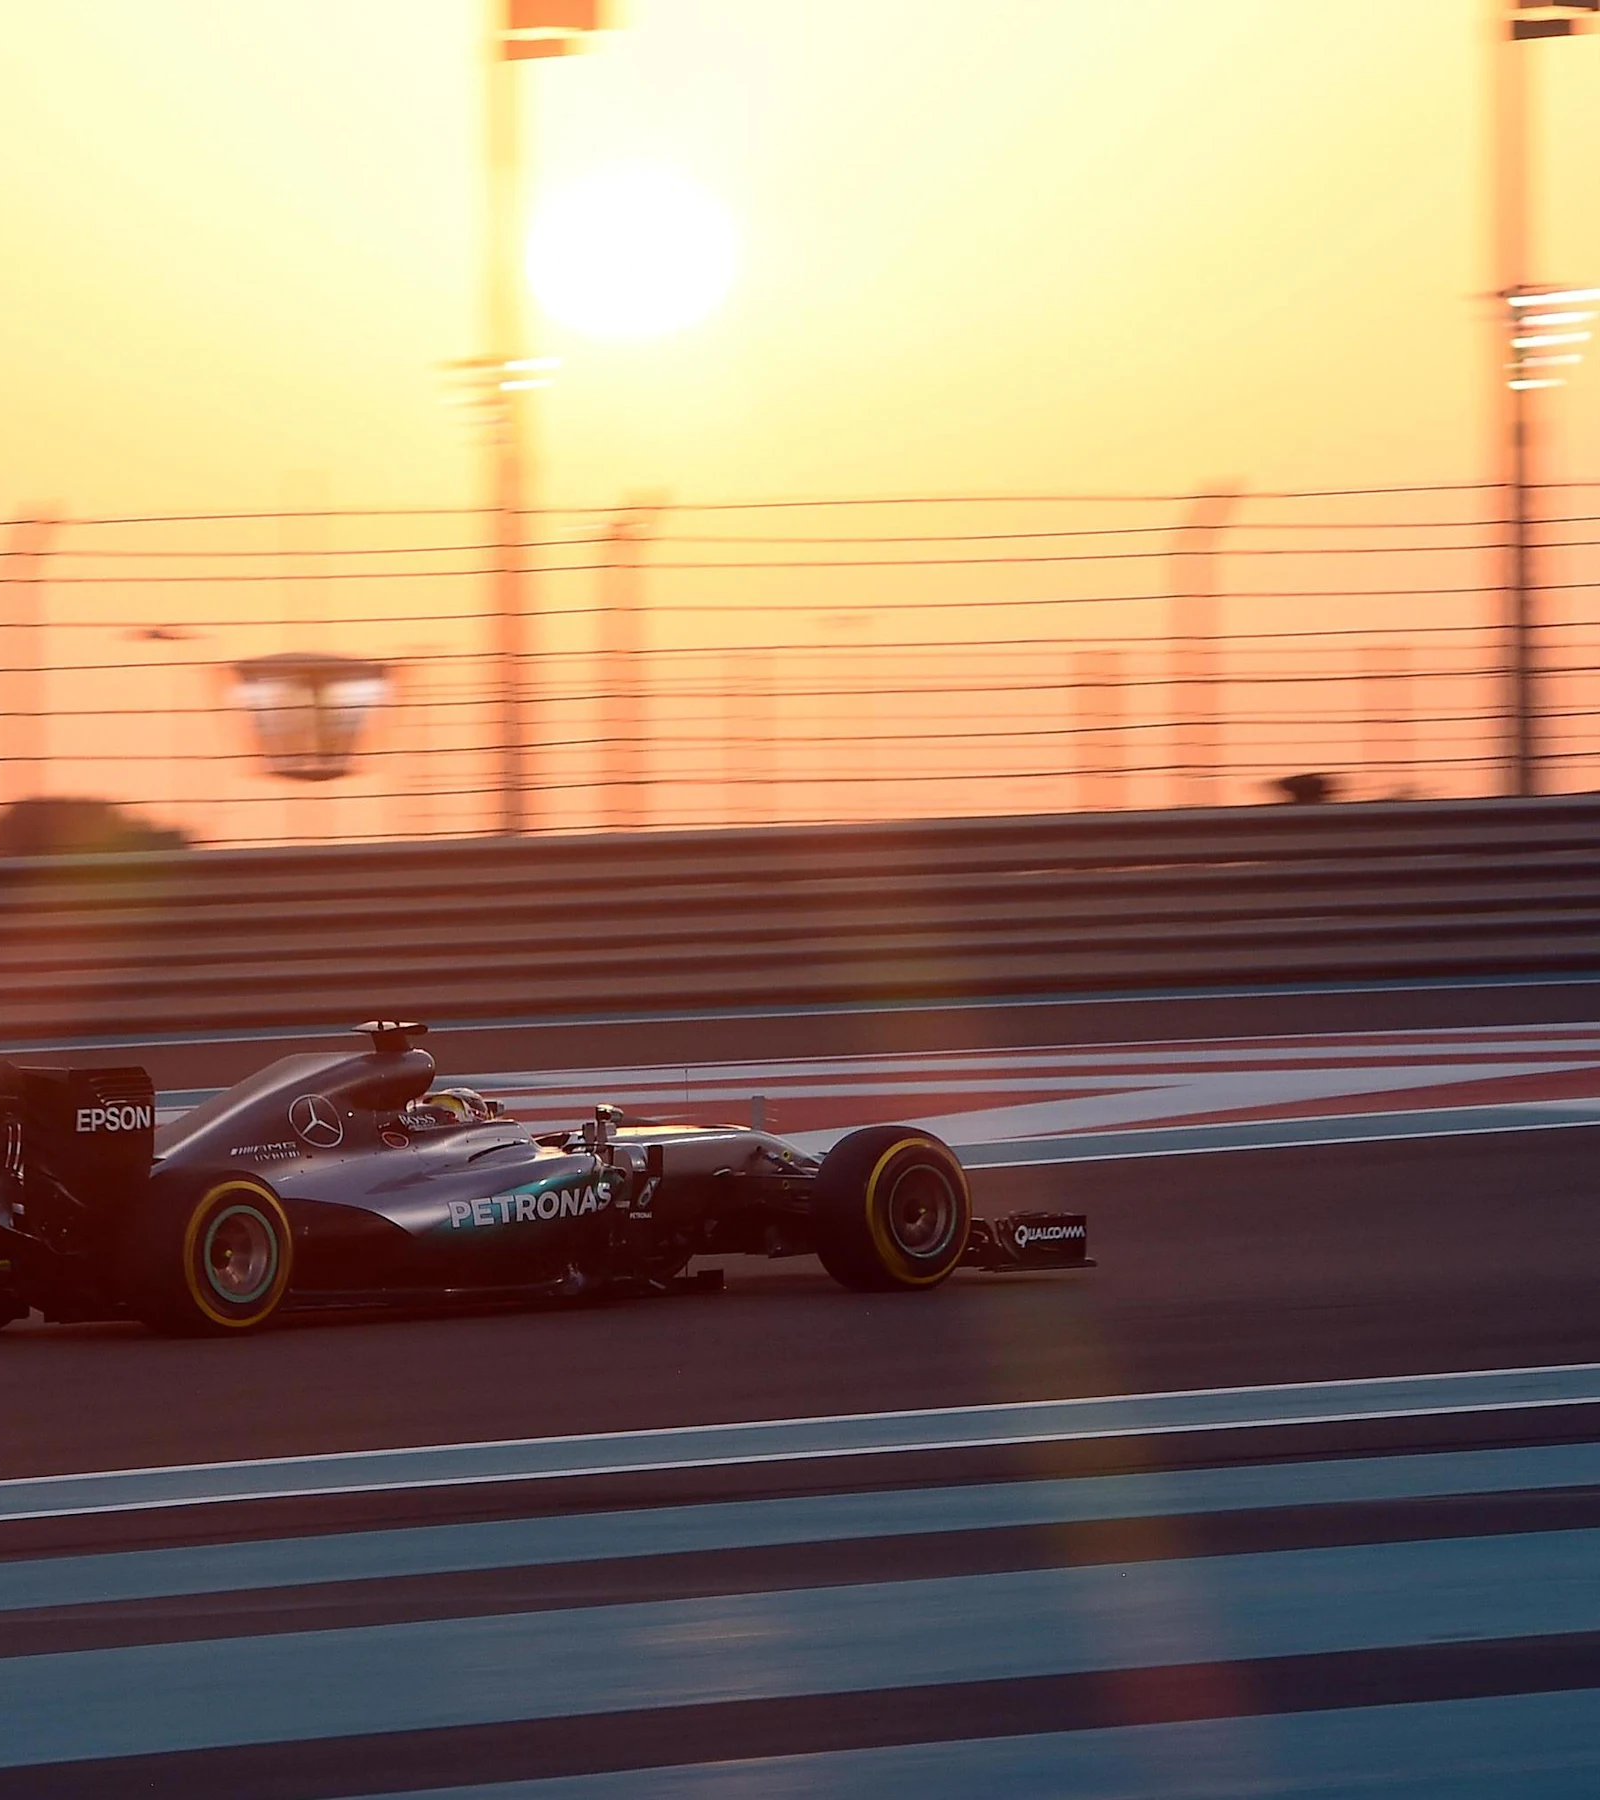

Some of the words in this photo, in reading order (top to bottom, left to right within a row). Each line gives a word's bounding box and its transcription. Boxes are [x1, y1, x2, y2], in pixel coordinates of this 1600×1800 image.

[76, 1105, 151, 1132] EPSON
[449, 1181, 612, 1229] PETRONAS
[1014, 1225, 1085, 1248] QUALCOMM
